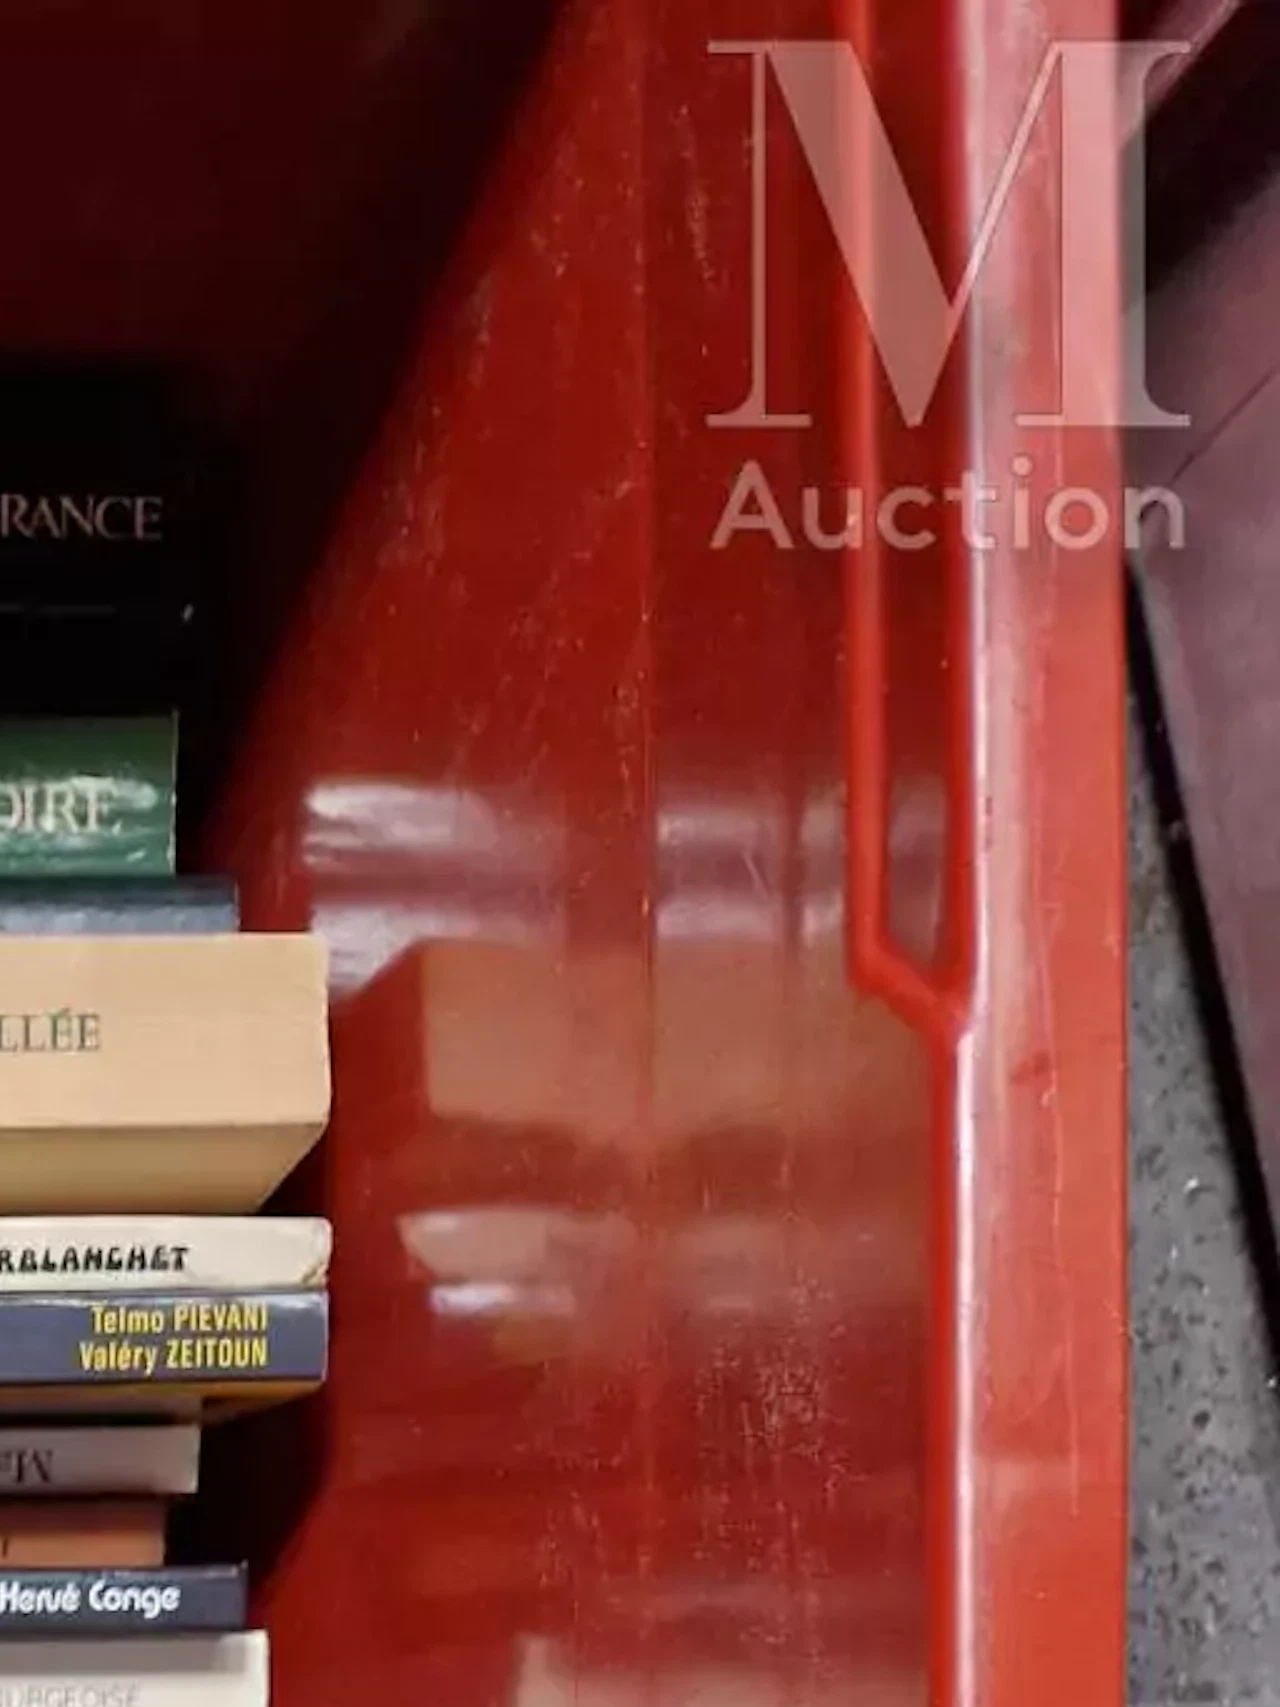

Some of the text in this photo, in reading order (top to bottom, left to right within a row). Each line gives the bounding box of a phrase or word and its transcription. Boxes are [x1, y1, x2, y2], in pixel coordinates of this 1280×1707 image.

[93, 1301, 269, 1336] Telmo PIEVANI
[79, 1338, 269, 1377] Valéry ZEITOUN
[87, 1579, 179, 1617] Conge
